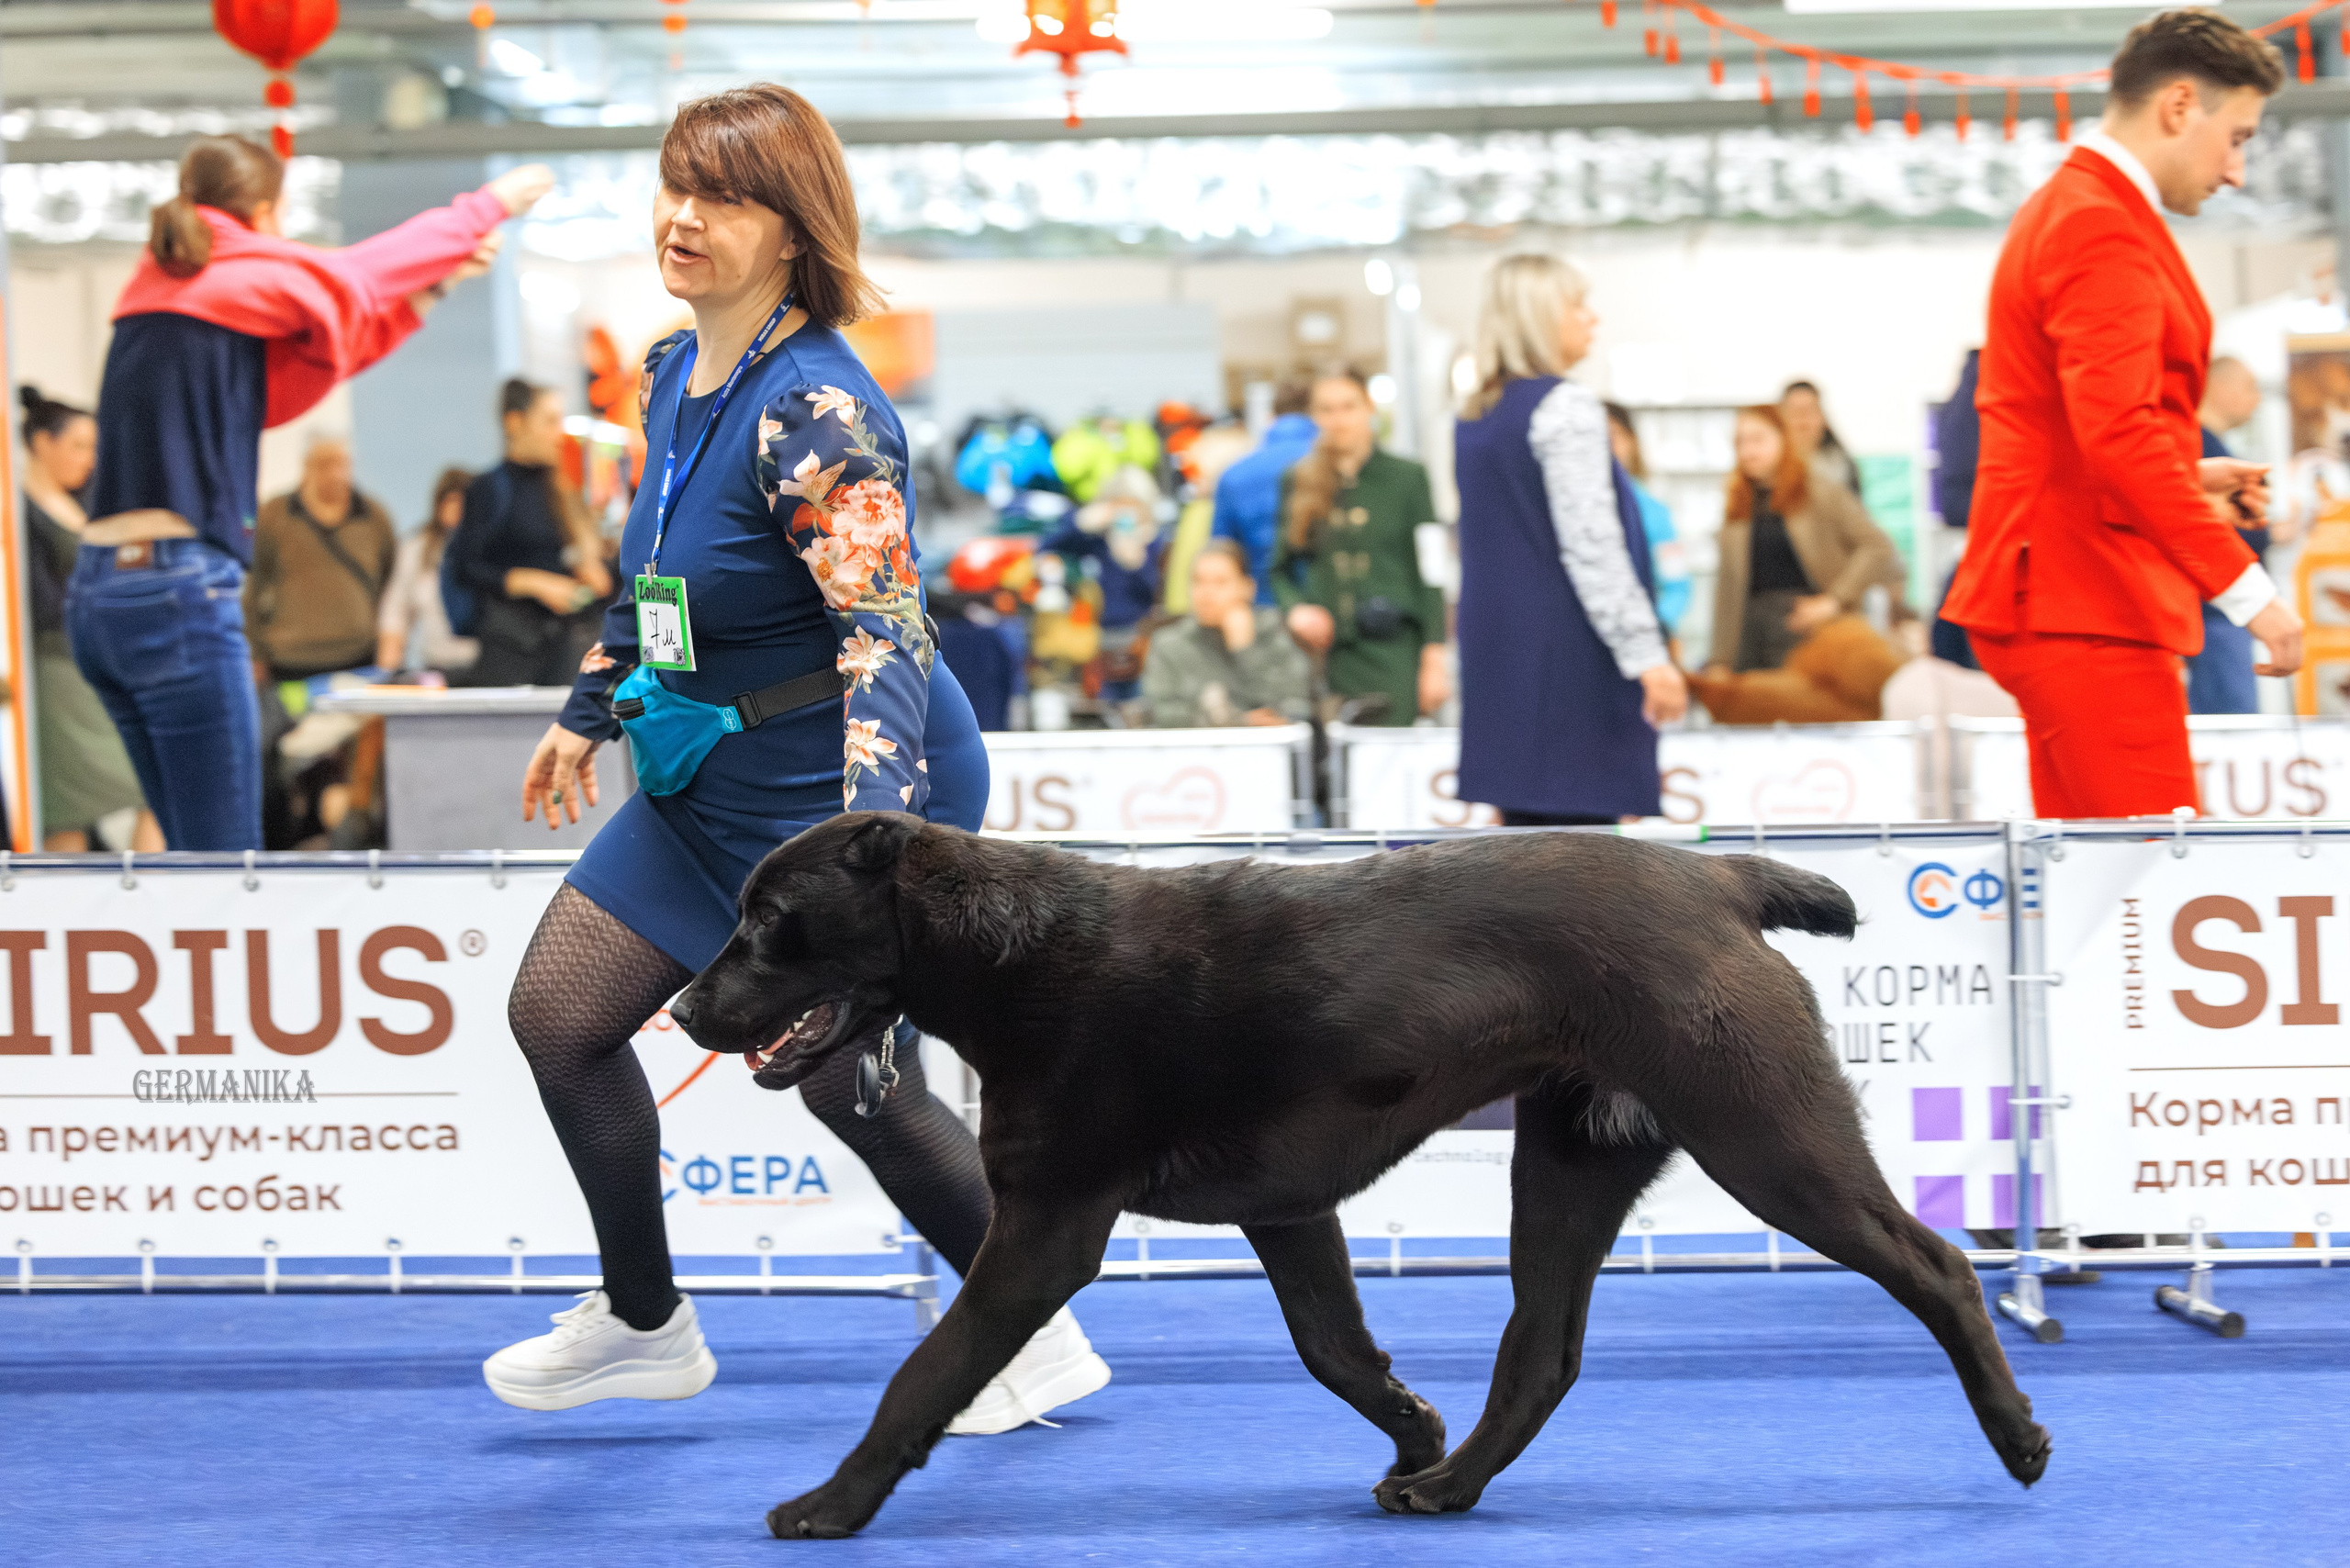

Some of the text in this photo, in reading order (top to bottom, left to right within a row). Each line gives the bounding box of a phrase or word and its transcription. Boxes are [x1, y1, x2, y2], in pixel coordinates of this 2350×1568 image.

[2121, 898, 2145, 1029] PREMIUM
[1842, 964, 1995, 1007] КОРМА
[1829, 1022, 1932, 1064] ШЕК
[2130, 1092, 2295, 1137] Корма
[28, 1124, 459, 1161] премиум-класса
[0, 1174, 342, 1213] ошек и собак
[659, 1148, 831, 1202] ФЕРА
[2133, 1158, 2350, 1193] для кош
